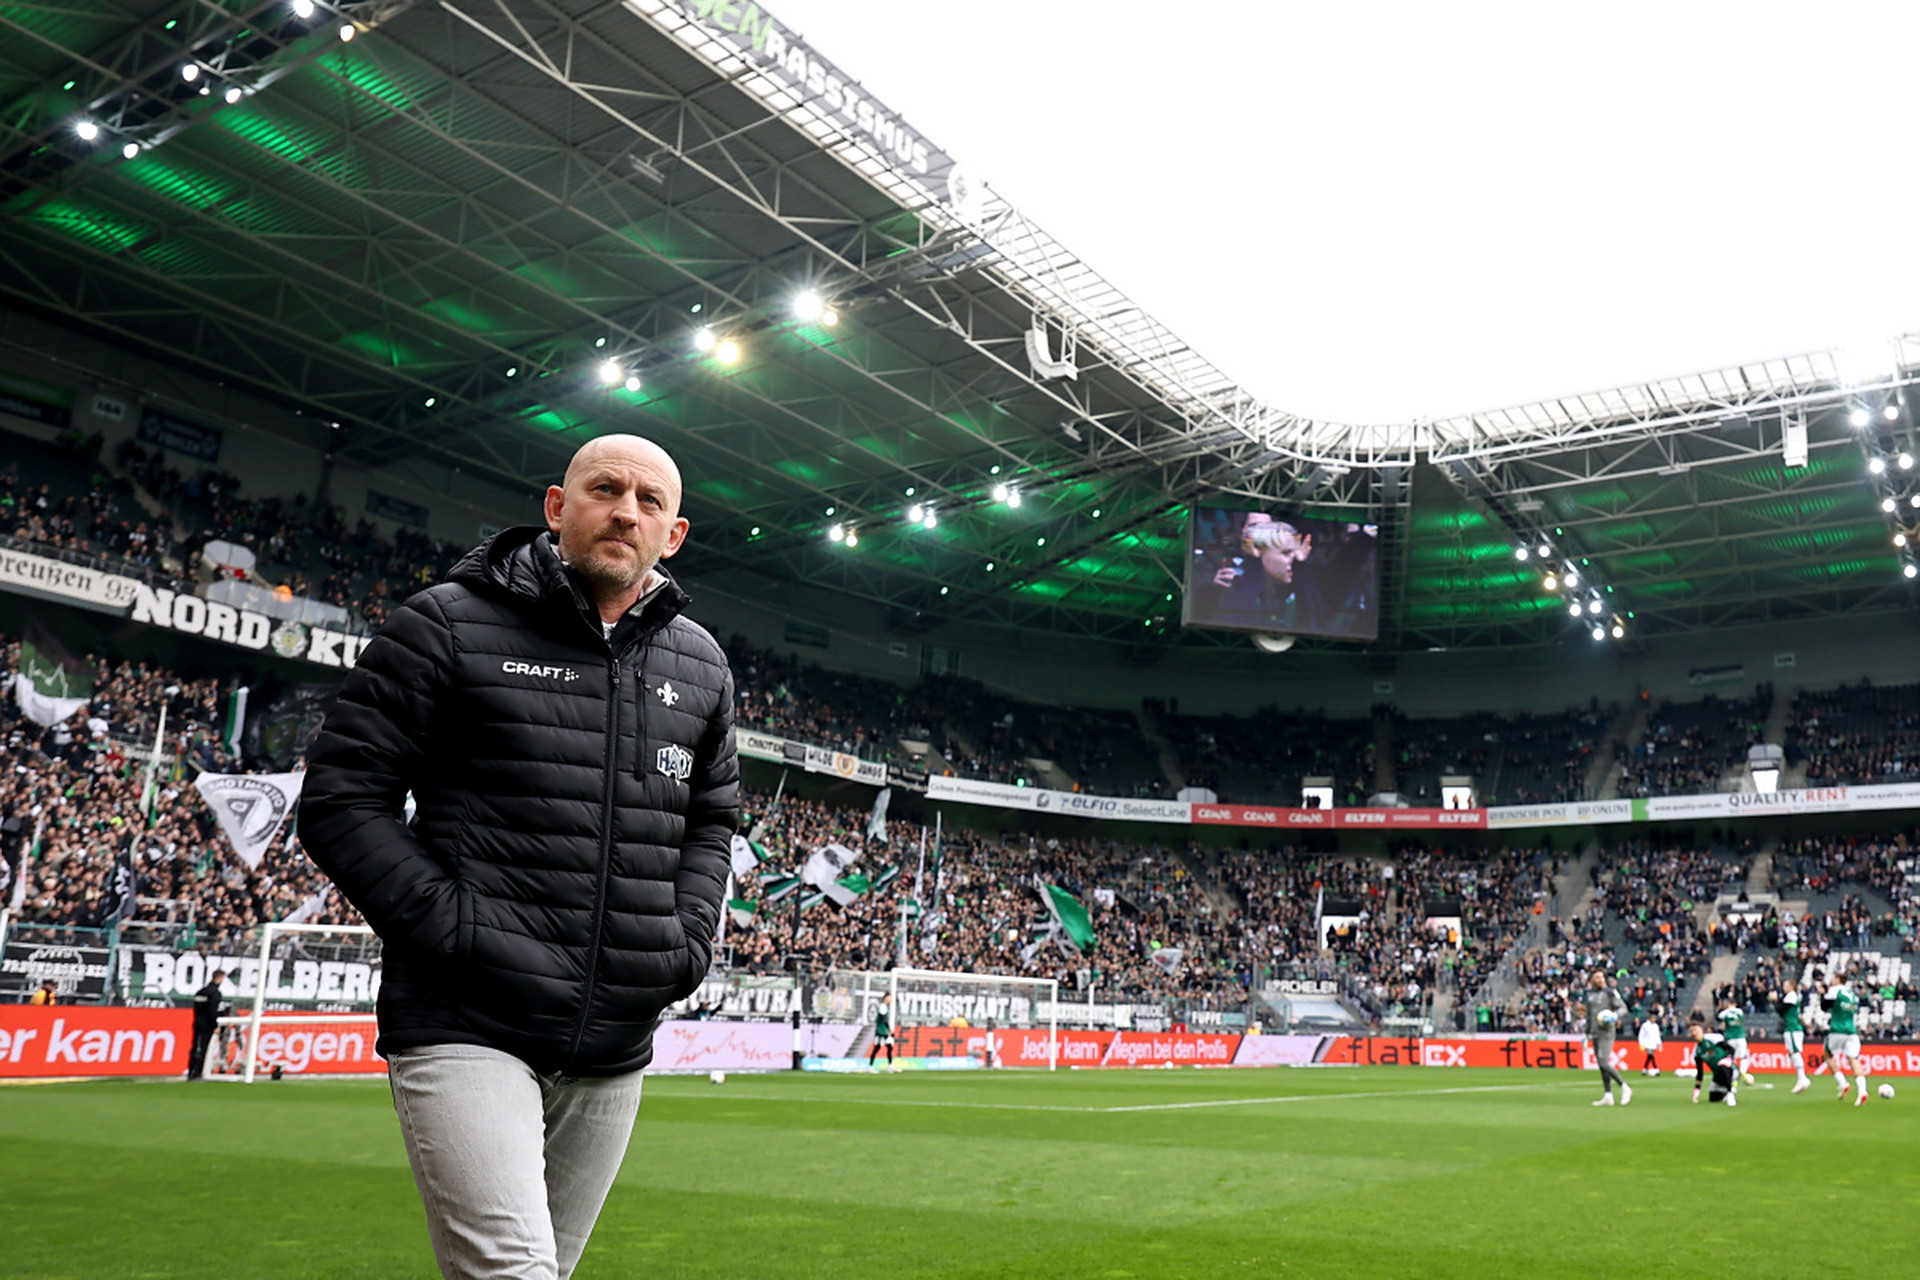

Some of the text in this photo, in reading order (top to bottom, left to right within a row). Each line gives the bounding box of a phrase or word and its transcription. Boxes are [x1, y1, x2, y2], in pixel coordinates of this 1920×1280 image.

[764, 28, 930, 174] RASSISMUS
[0, 551, 92, 591] reußen
[131, 586, 271, 650] NORD
[502, 661, 563, 680] CRAFT
[1123, 803, 1187, 818] SelectLine
[1344, 812, 1386, 823] ELTEN
[1438, 812, 1481, 823] ELTEN
[1542, 807, 1567, 818] POST
[1592, 804, 1629, 814] ONLINE
[46, 1018, 175, 1063] kann
[1063, 1036, 1099, 1059] kann
[1153, 1038, 1173, 1060] bei
[1173, 1039, 1196, 1060] den
[1196, 1039, 1228, 1060] Profis
